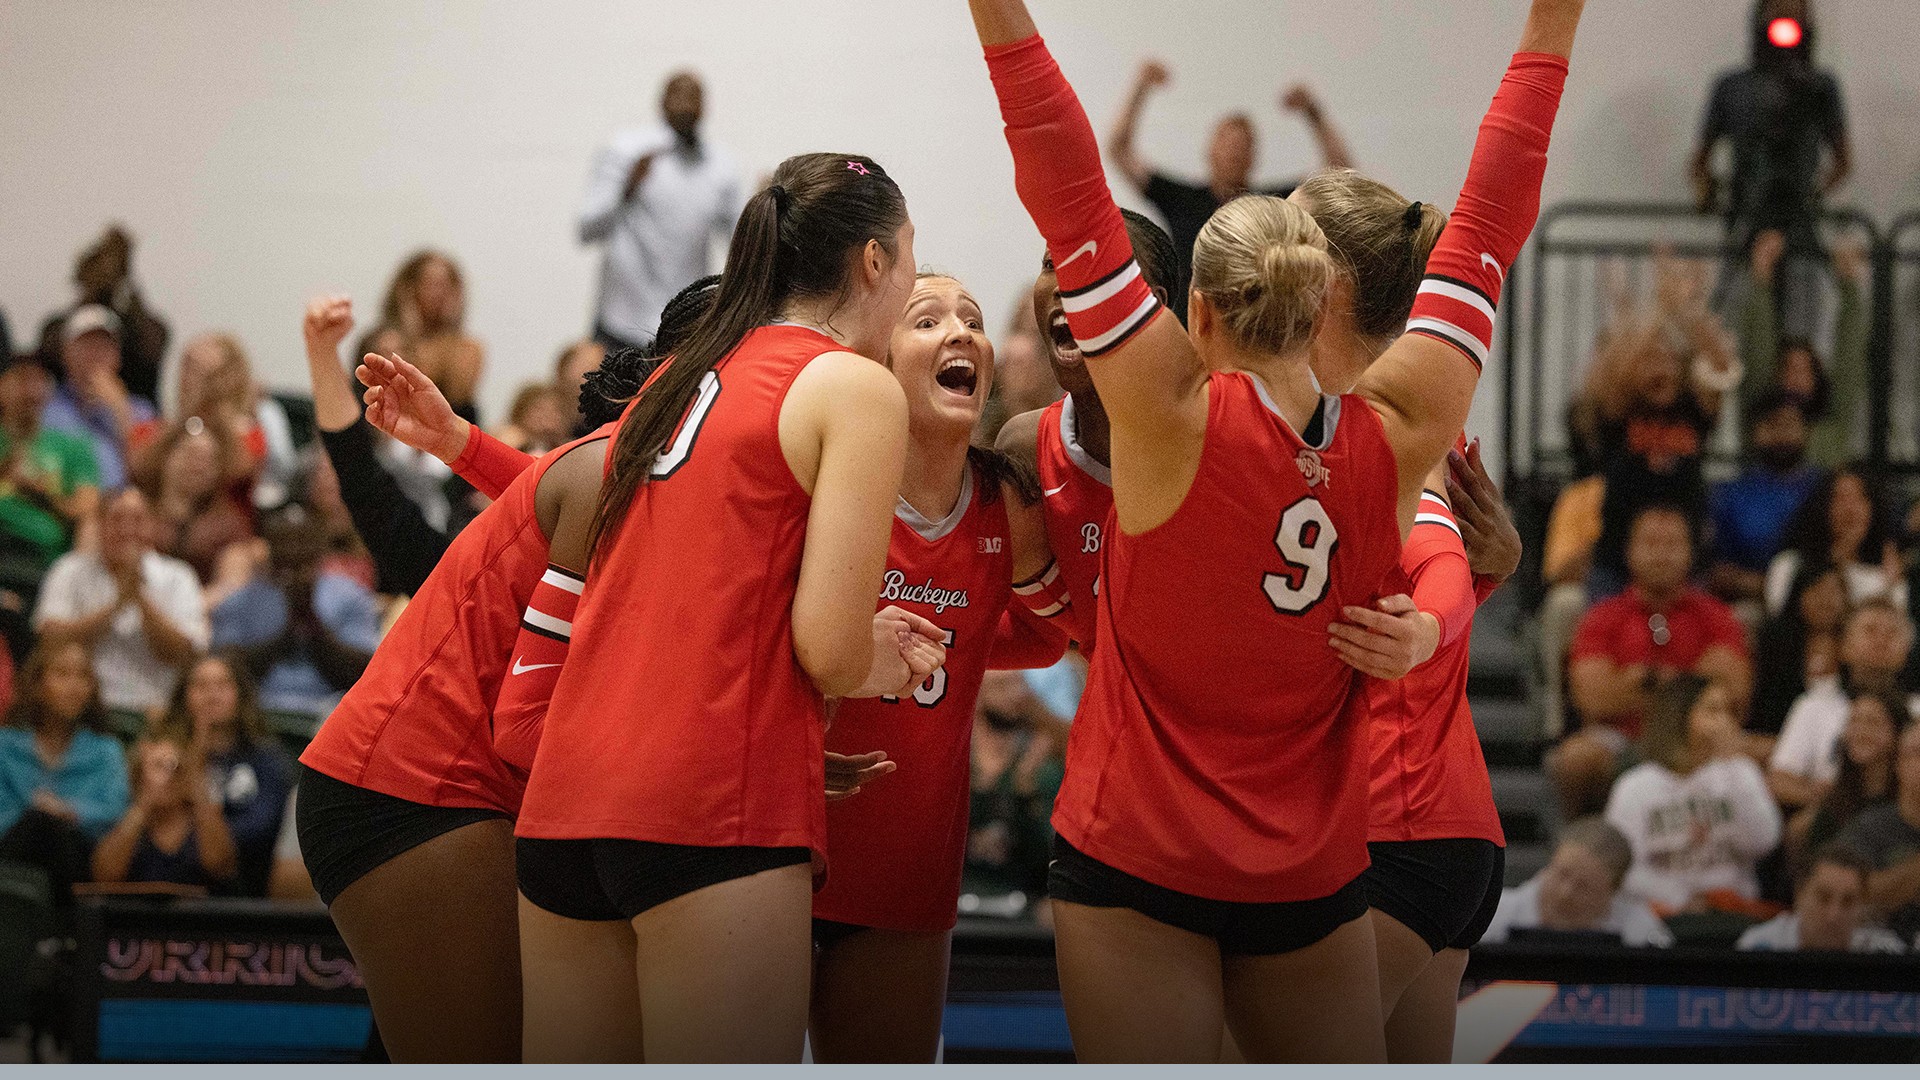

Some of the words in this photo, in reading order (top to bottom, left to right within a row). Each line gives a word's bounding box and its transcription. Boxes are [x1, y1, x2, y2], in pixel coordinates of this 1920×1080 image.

[1080, 522, 1104, 555] B
[1260, 495, 1339, 616] 9
[879, 569, 969, 614] Buckeyes
[880, 628, 956, 709] 5
